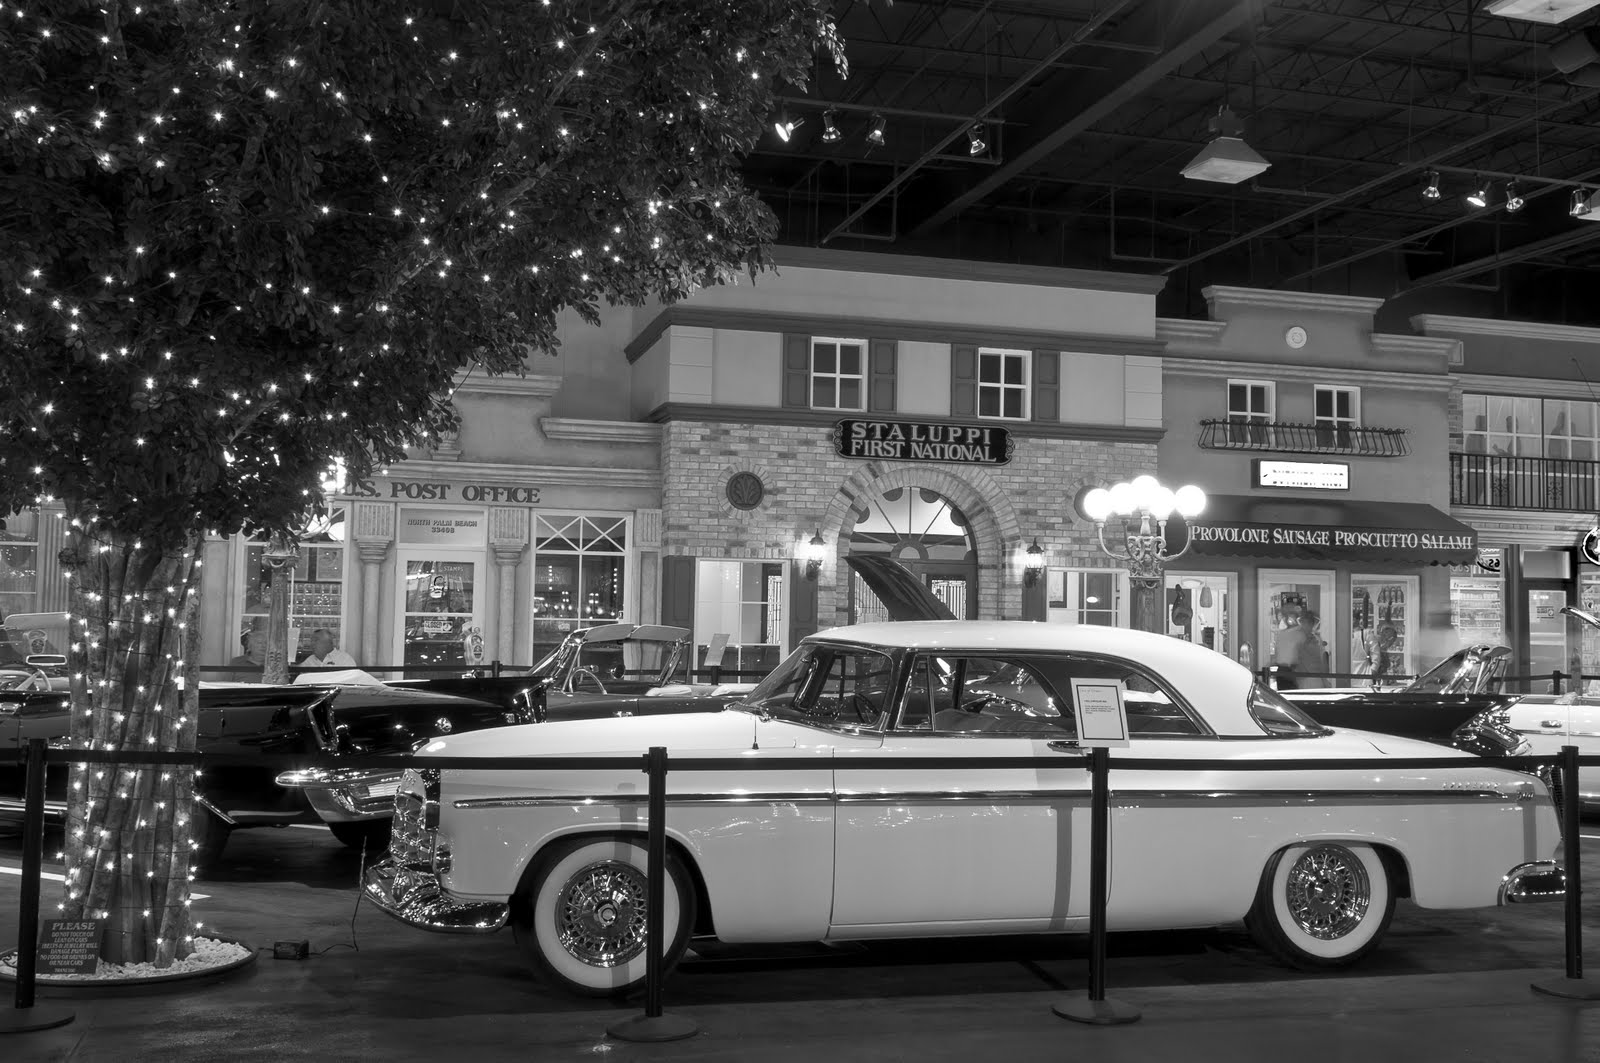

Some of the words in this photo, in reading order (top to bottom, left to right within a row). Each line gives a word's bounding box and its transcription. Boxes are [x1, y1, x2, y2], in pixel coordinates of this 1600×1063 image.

[850, 422, 991, 445] STALUPPI
[851, 439, 906, 458] FIRST
[910, 442, 997, 462] NATIONAL
[390, 481, 451, 500] POST
[462, 485, 541, 504] OFFICE
[407, 518, 431, 526] NORTH
[433, 519, 453, 527] PALM
[1191, 525, 1270, 544] PROVOLONE
[1273, 528, 1330, 546] SAUSAGE
[1335, 530, 1418, 549] PROSCIUTTO
[1421, 534, 1474, 550] SALAMI
[52, 922, 96, 930] PLEASE
